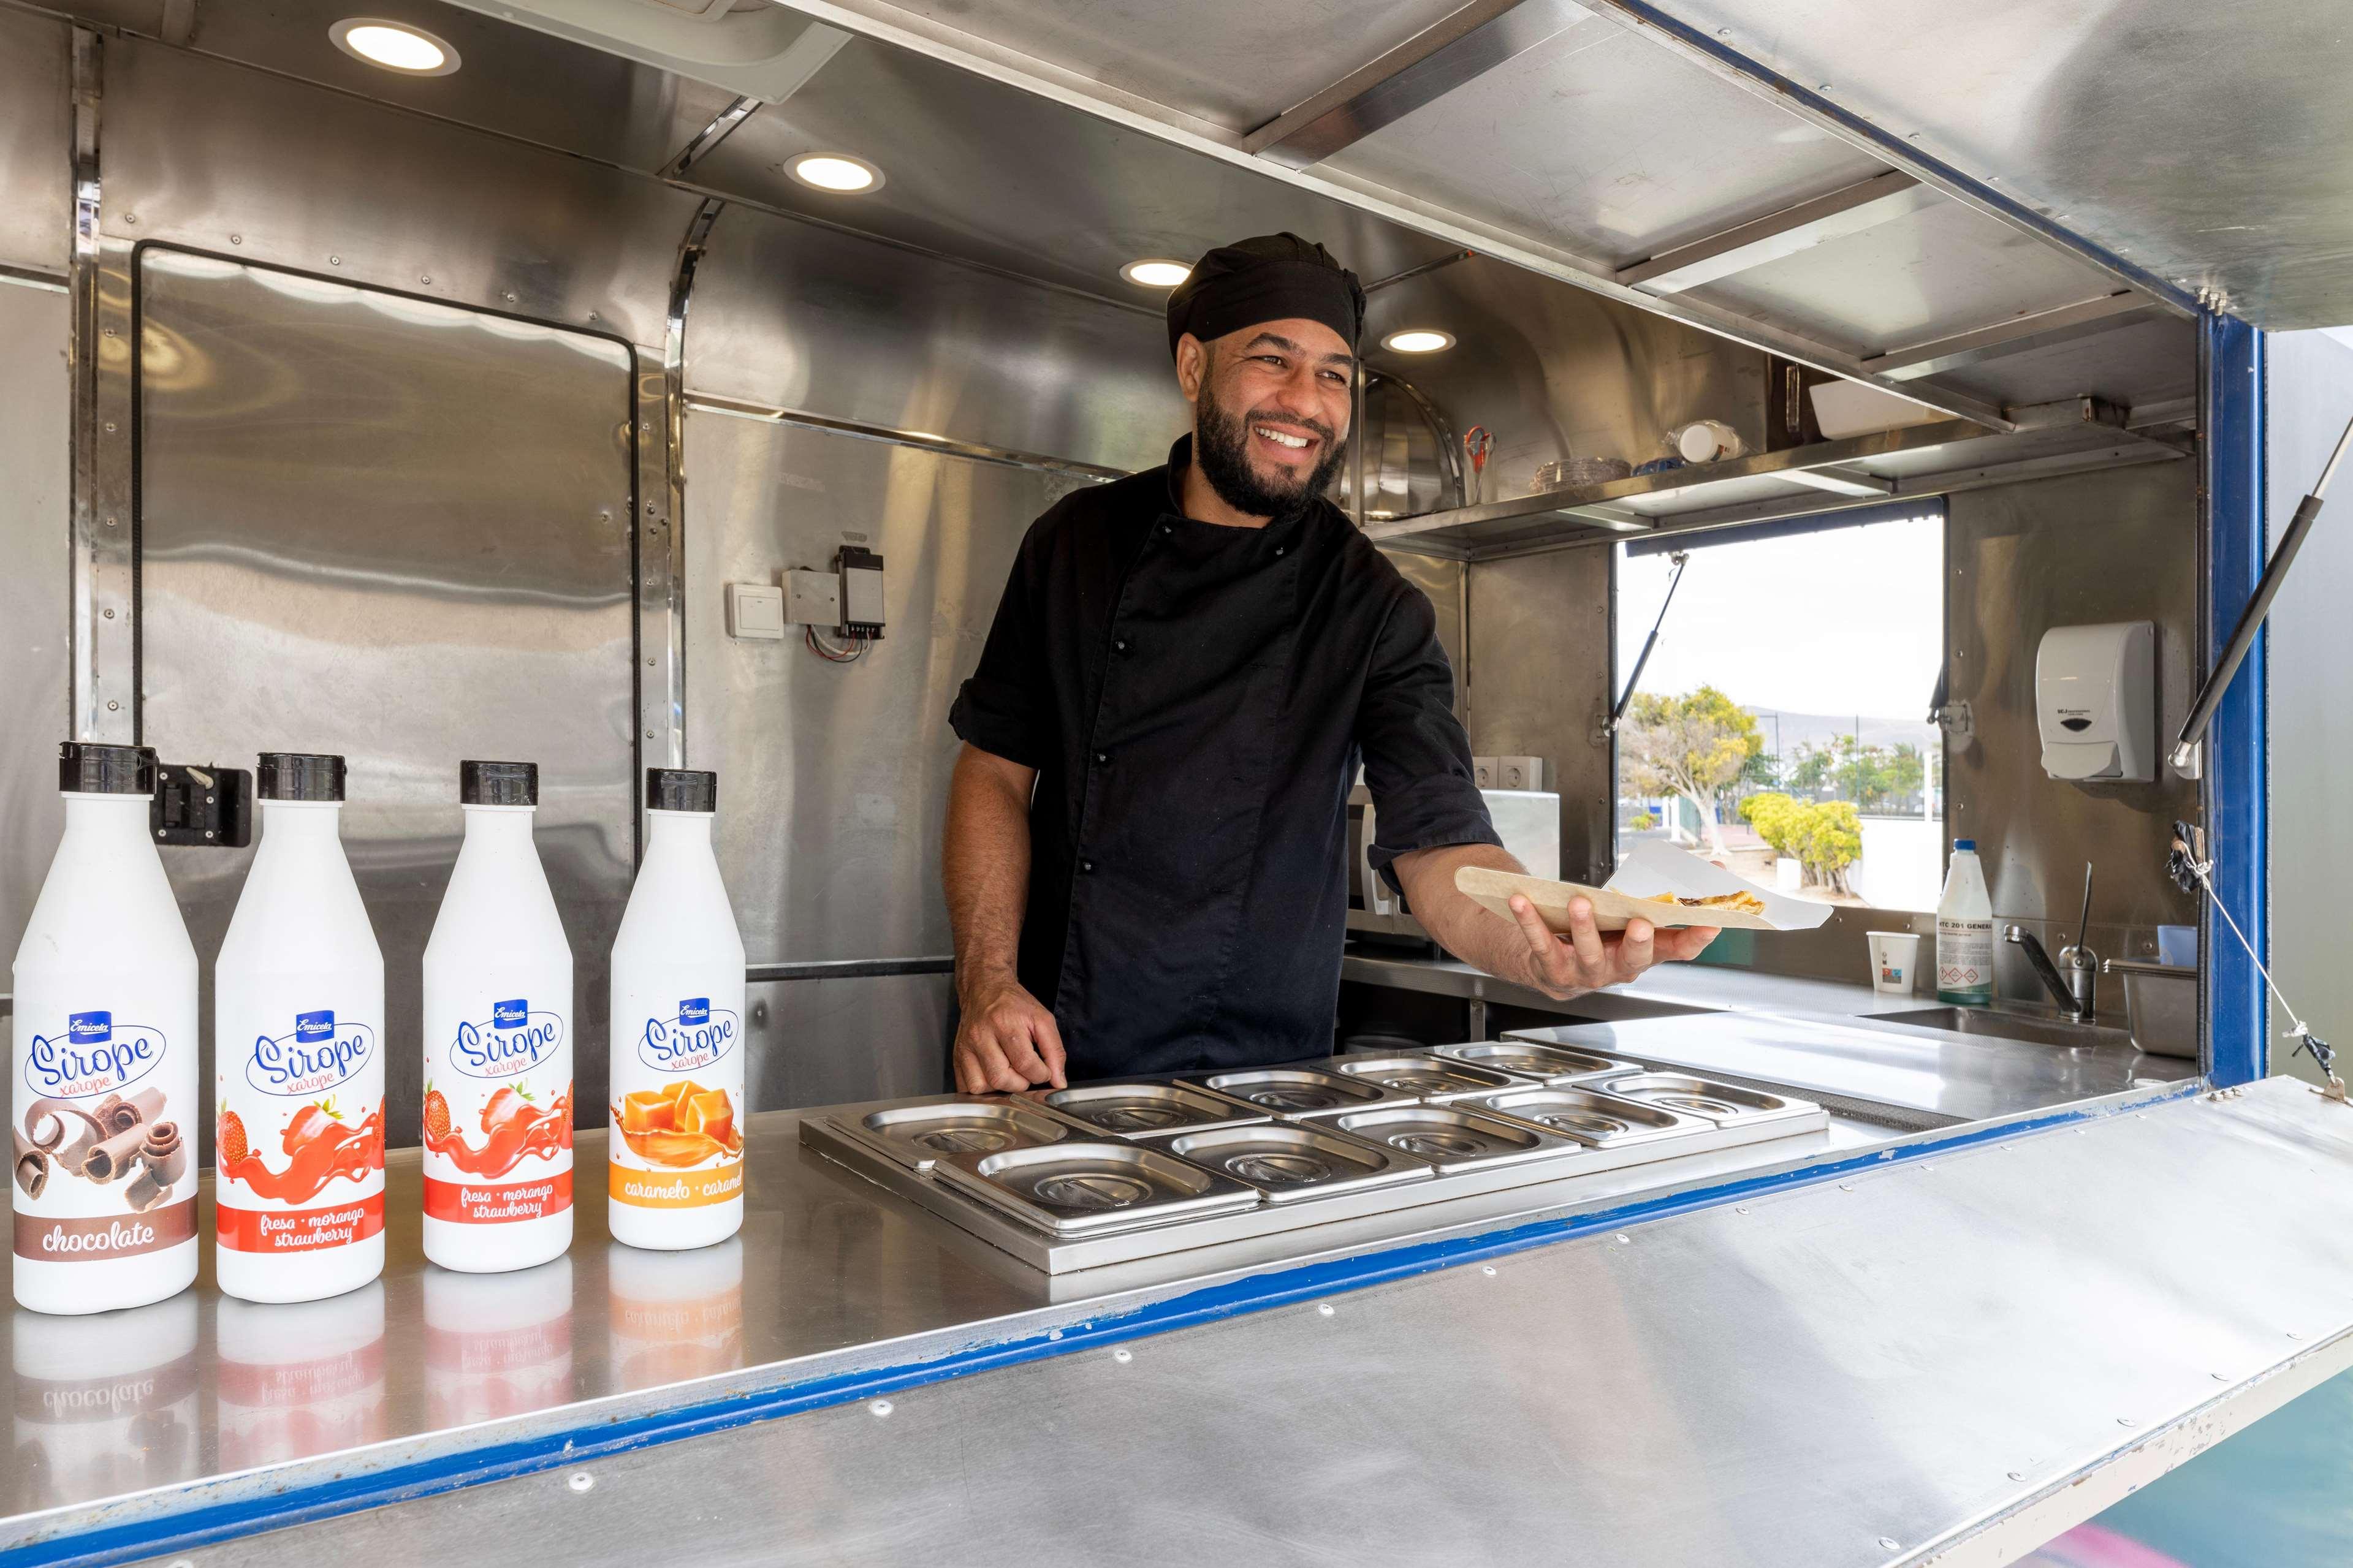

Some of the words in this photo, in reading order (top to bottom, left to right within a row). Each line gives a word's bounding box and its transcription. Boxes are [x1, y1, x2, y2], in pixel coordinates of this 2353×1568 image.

[495, 1006, 526, 1021] Emicela
[70, 1018, 109, 1034] Emicela
[297, 1018, 332, 1034] Emicela
[457, 1021, 555, 1066] Sirope
[646, 1018, 734, 1061] Sirope
[32, 1034, 154, 1085] Sirope
[255, 1035, 367, 1084] Sirope
[484, 1057, 528, 1077] xarope
[671, 1053, 710, 1070] xarope
[59, 1075, 112, 1097] xarope
[286, 1073, 335, 1094] xarope
[625, 1178, 690, 1199] caramelo
[702, 1166, 742, 1196] caramel
[461, 1187, 492, 1208] fresa
[503, 1184, 553, 1202] morango
[260, 1214, 295, 1236] fresa
[308, 1207, 364, 1226] morango
[473, 1202, 542, 1219] strawberry
[42, 1221, 154, 1252] chocolate
[275, 1227, 353, 1247] strawberry
